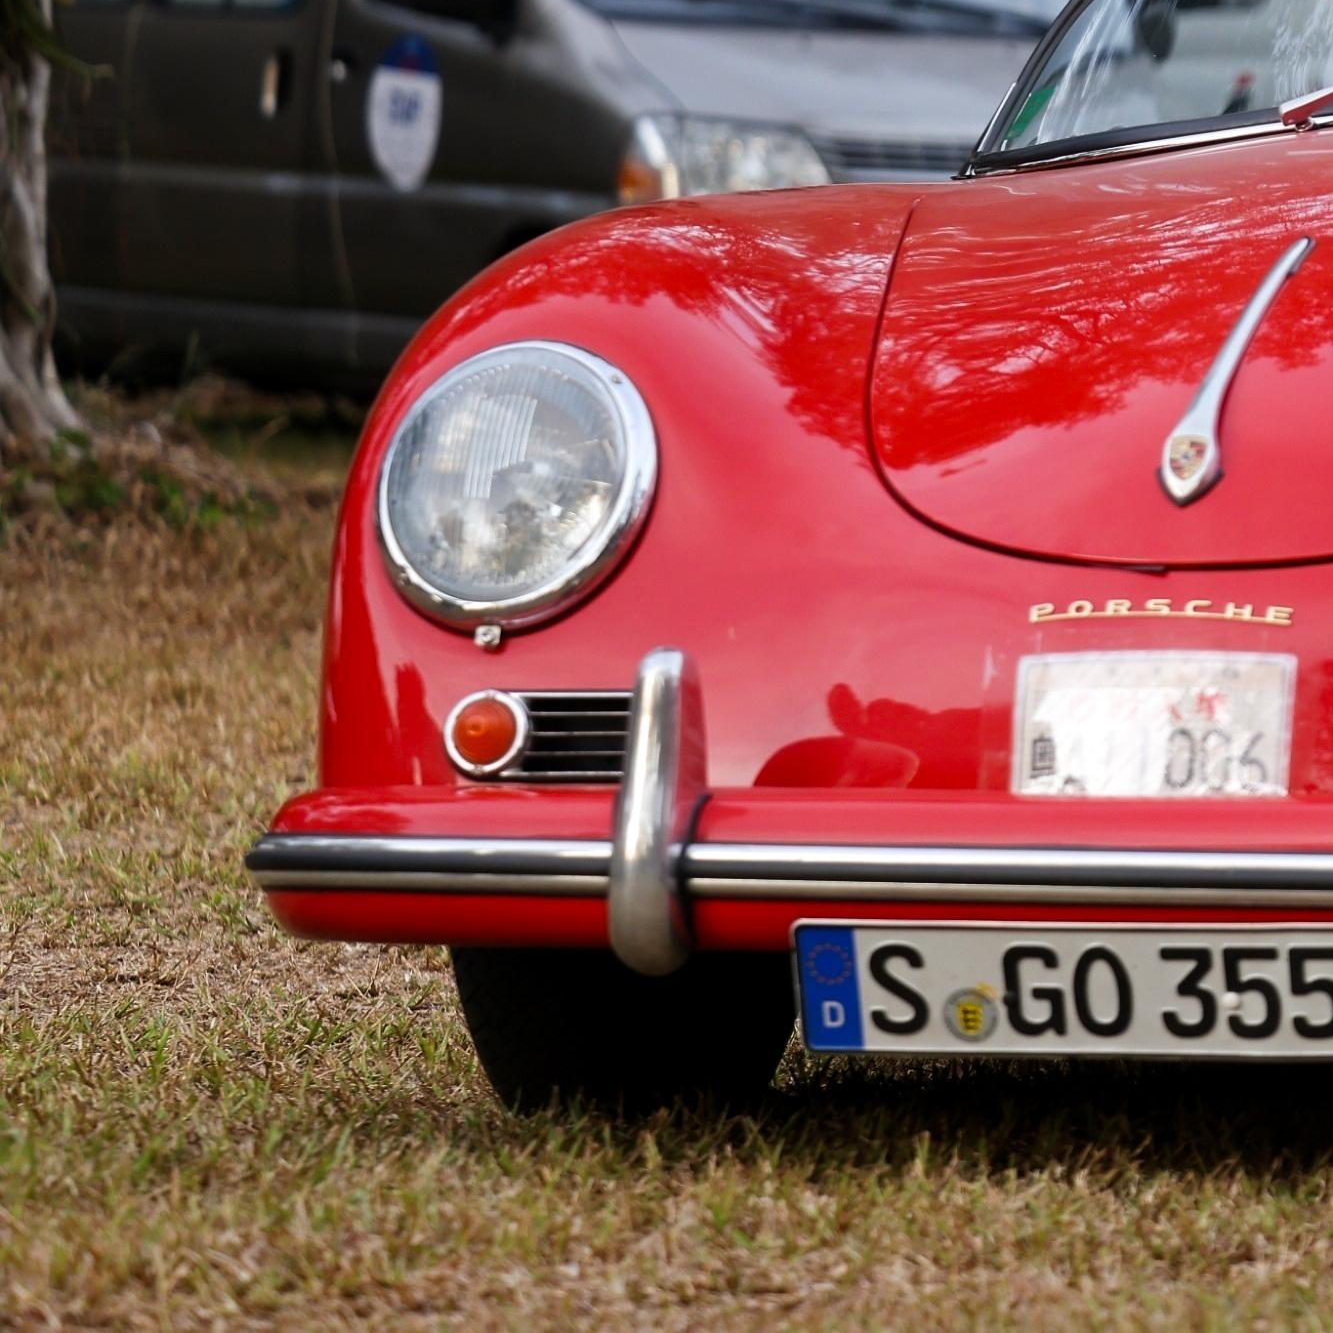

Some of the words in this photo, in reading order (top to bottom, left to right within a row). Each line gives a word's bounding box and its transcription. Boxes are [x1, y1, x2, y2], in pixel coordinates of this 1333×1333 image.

[1029, 598, 1294, 626] PORSCHE
[867, 943, 930, 1035] S
[1003, 944, 1133, 1037] GO
[822, 1001, 846, 1028] D
